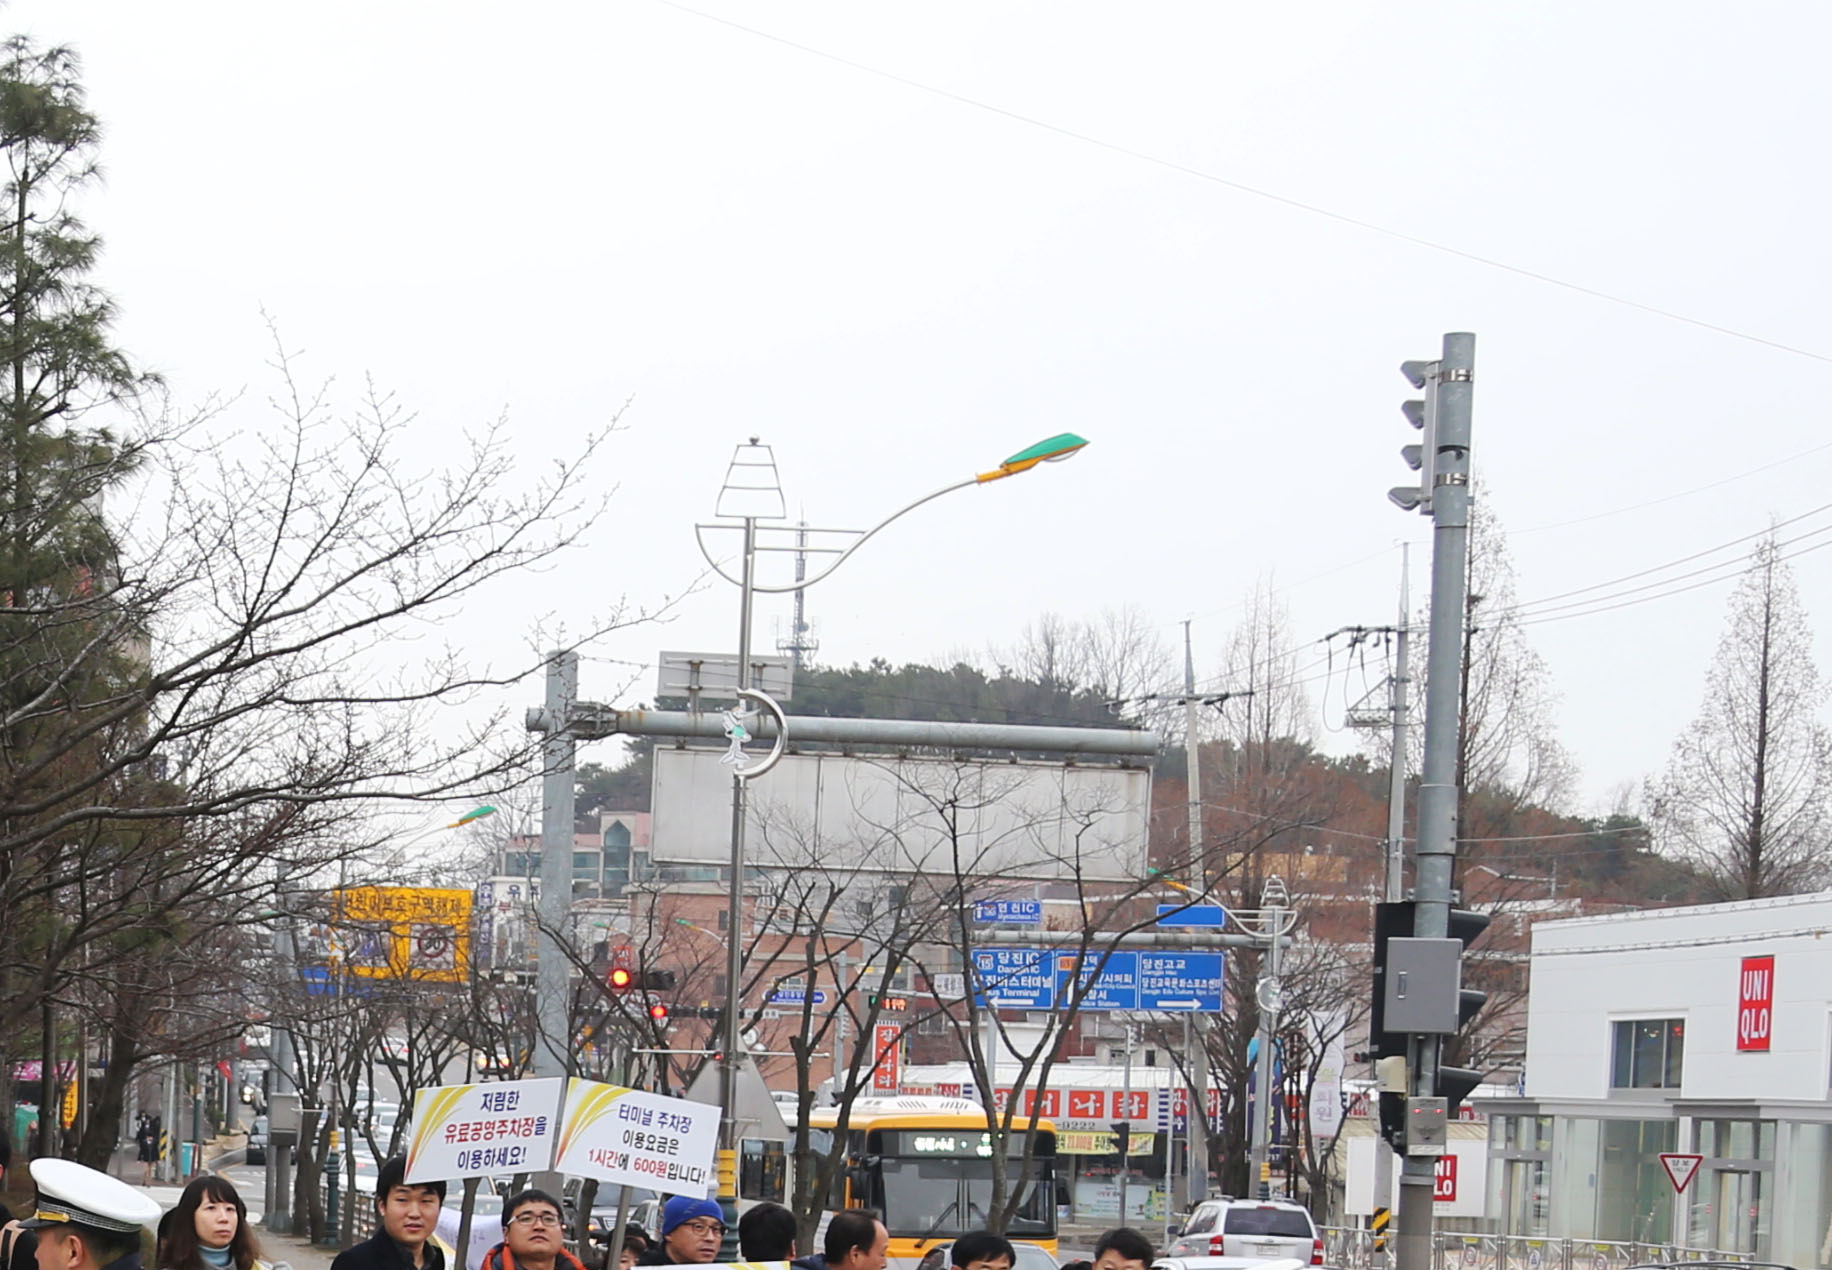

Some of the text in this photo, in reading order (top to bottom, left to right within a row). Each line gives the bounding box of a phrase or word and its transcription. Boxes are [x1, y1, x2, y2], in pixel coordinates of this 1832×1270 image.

[1743, 969, 1768, 1001] UNI
[1741, 1008, 1768, 1044] QLO
[480, 1090, 520, 1112] 저렴한
[444, 1116, 548, 1144] 유료공영주차장을
[619, 1104, 693, 1135] 터미널 주차장
[622, 1129, 680, 1156] 이용요금은
[458, 1147, 527, 1171] 이용하세요!
[588, 1148, 706, 1184] 1시간에 600원입니다!
